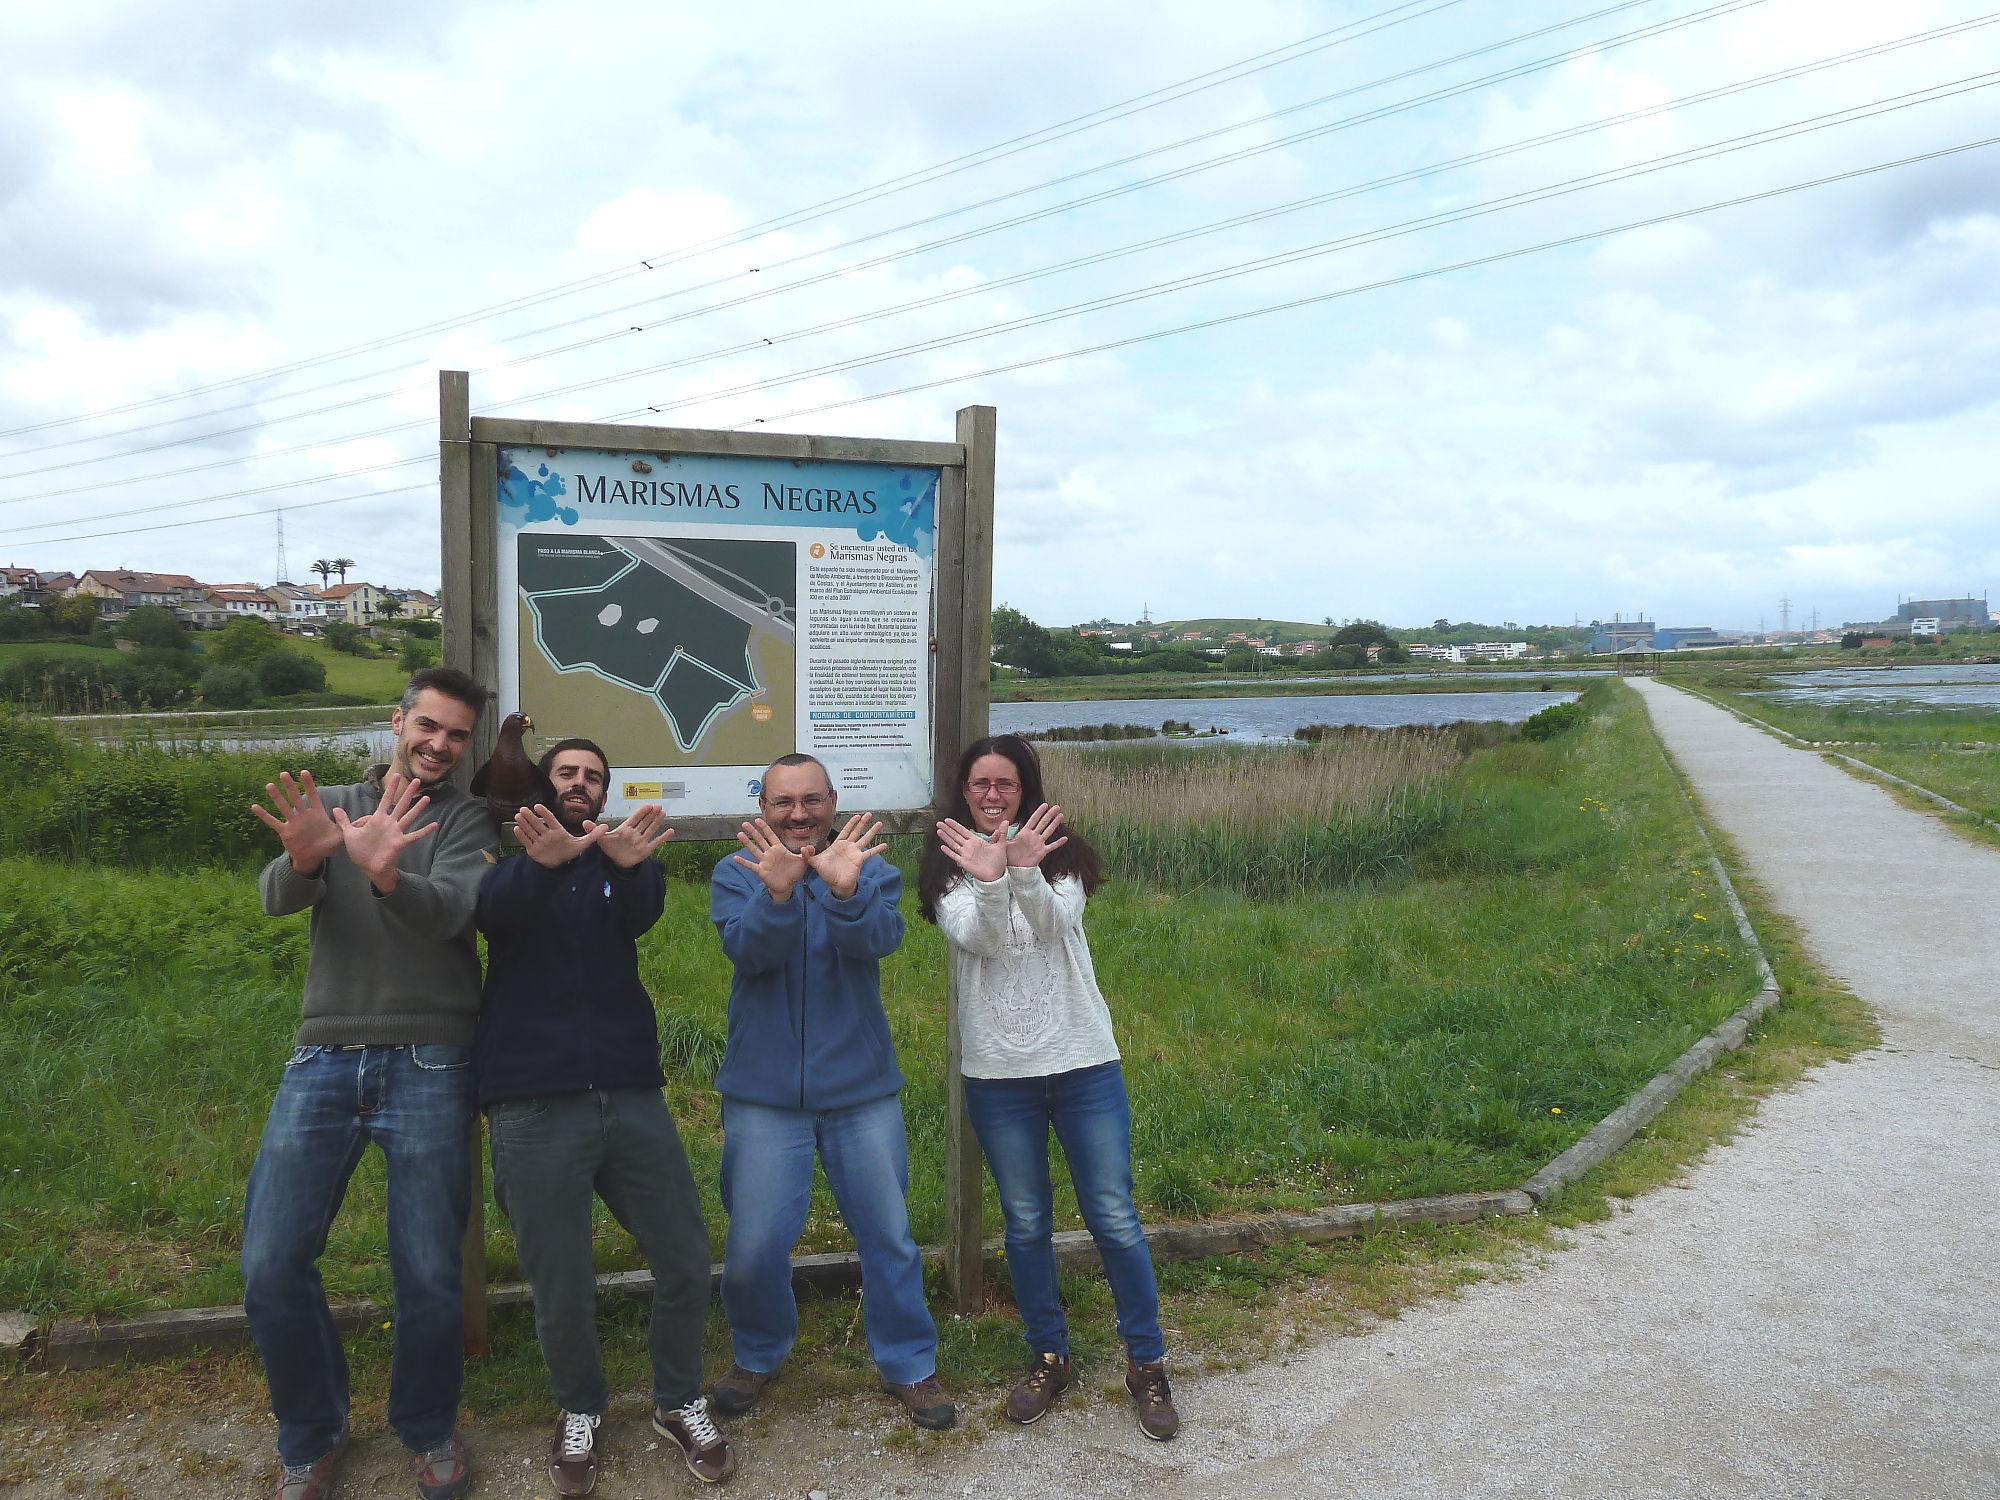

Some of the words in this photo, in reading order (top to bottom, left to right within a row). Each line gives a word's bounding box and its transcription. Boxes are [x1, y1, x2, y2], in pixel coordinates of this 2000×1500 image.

[575, 474, 740, 509] MARISMAS
[761, 482, 877, 514] NEGRAS
[829, 543, 838, 551] Se
[840, 545, 875, 553] encuentra
[877, 545, 896, 553] usted
[830, 551, 874, 562] Marismas
[876, 552, 908, 563] Negras
[856, 711, 913, 719] COMPORTAMIENTO
